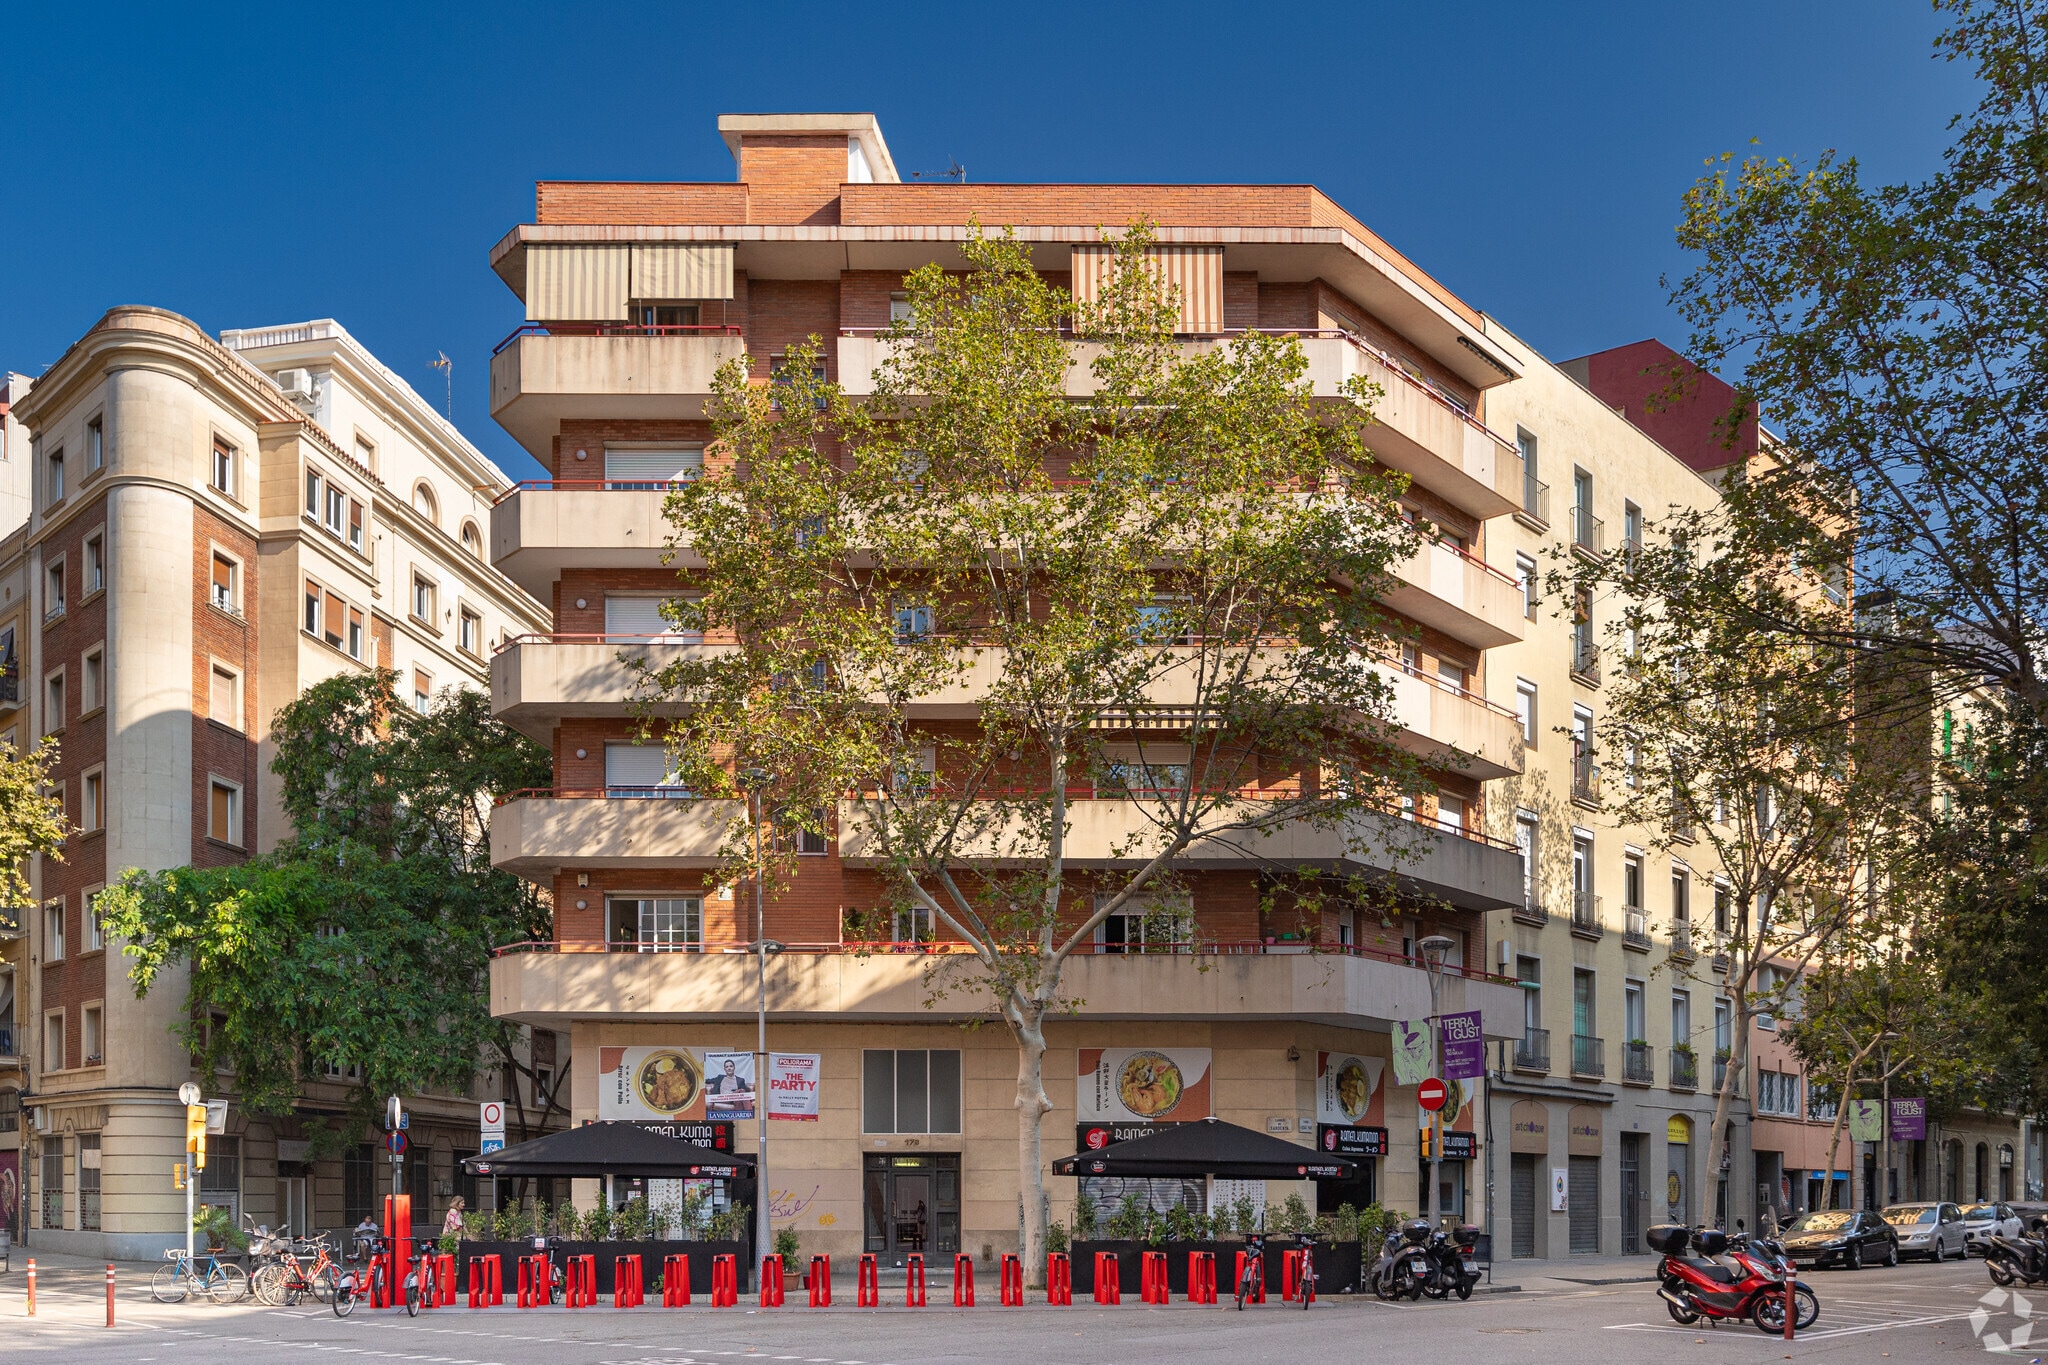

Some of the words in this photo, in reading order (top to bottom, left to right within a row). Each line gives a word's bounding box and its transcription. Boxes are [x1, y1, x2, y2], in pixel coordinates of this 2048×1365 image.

[1443, 1016, 1474, 1030] TERRA
[1449, 1029, 1452, 1040] I
[1453, 1026, 1480, 1040] GUST
[770, 1079, 817, 1091] PARTY
[1892, 1101, 1918, 1109] TERRA
[1900, 1107, 1923, 1115] GUST
[637, 1125, 680, 1138] MEN
[680, 1126, 712, 1138] KUMA
